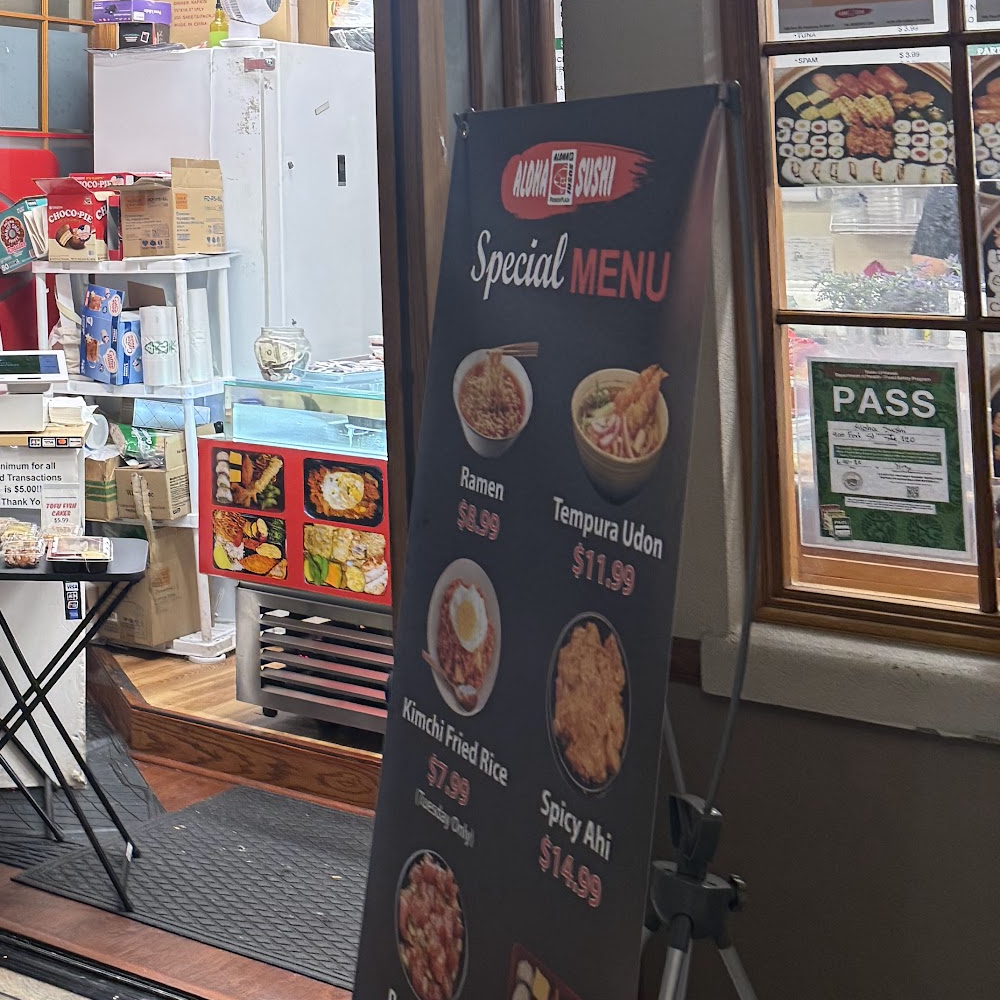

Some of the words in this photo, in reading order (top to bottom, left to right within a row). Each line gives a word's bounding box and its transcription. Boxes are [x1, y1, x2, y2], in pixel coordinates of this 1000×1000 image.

[513, 158, 550, 198] ALOHA
[575, 155, 617, 198] SUSHI
[470, 229, 568, 300] Special
[570, 247, 671, 302] MENU
[832, 386, 936, 419] PASS
[7, 473, 62, 482] Transactions
[31, 462, 43, 470] for
[45, 462, 56, 470] all
[460, 466, 504, 501] Ramen
[1, 498, 27, 506] Thank
[30, 498, 41, 506] Yo
[4, 485, 12, 493] is
[457, 499, 500, 541] $8.99
[553, 496, 619, 542] Tempura
[622, 519, 663, 560] Udon
[571, 542, 636, 596] $11.99
[402, 696, 445, 743] Kimchi
[446, 724, 480, 765] Fried
[479, 747, 508, 787] Rice
[426, 753, 471, 806] $7.99
[539, 789, 582, 843] Spicy
[583, 819, 612, 861] Ahi
[538, 834, 602, 908] $14.99
